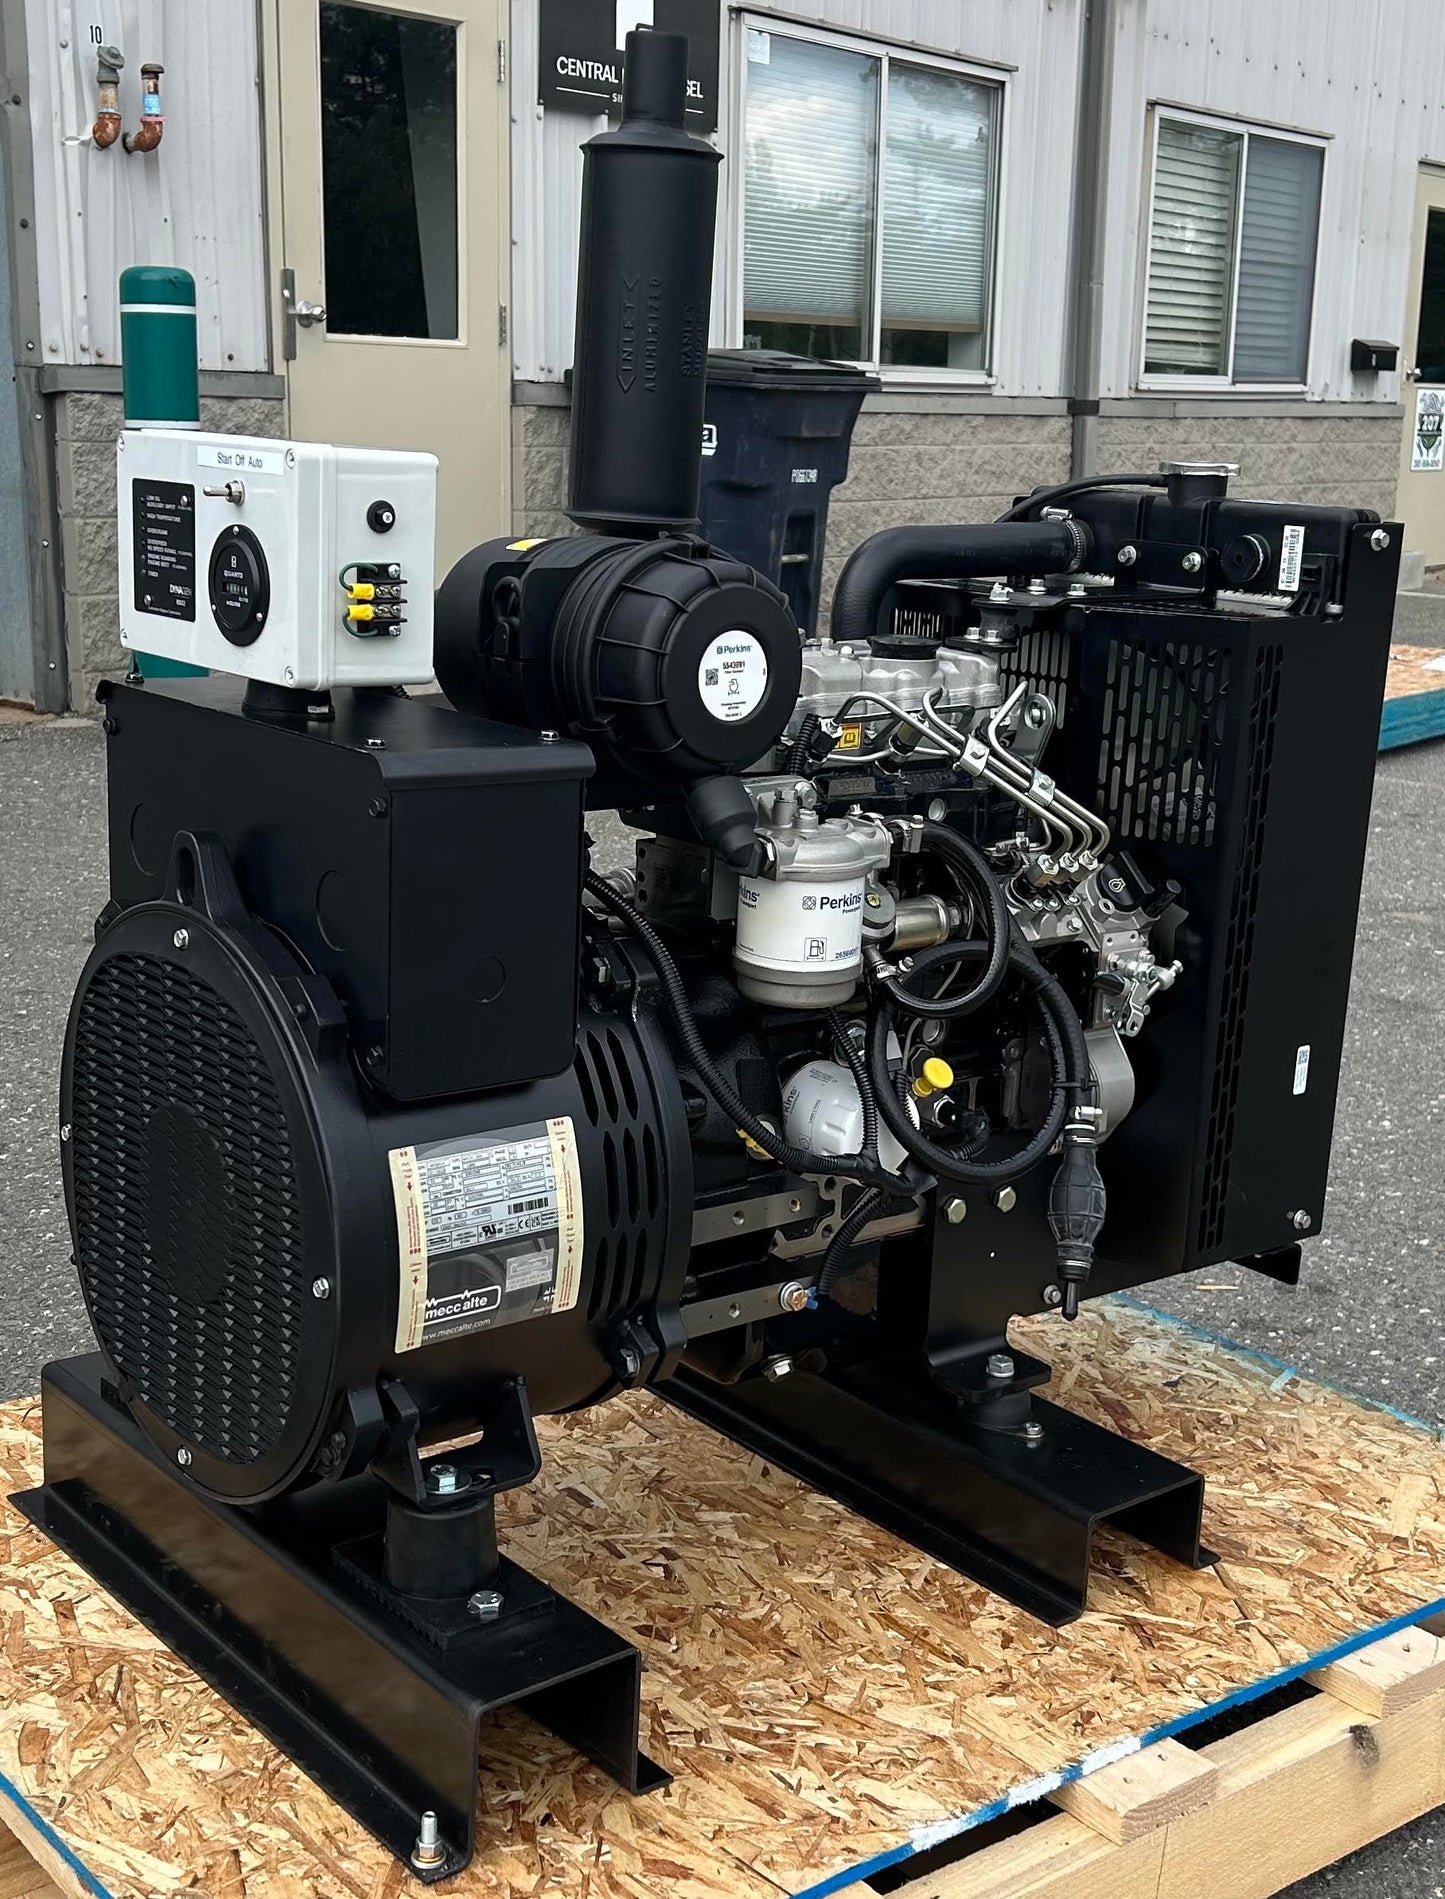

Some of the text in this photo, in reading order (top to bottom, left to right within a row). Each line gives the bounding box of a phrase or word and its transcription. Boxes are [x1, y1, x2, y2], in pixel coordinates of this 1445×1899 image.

[89, 25, 102, 45] 10
[556, 56, 619, 83] CENTRAL
[217, 451, 263, 468] Start Off Auto
[724, 645, 752, 654] Perkins
[820, 892, 862, 910] Perkins
